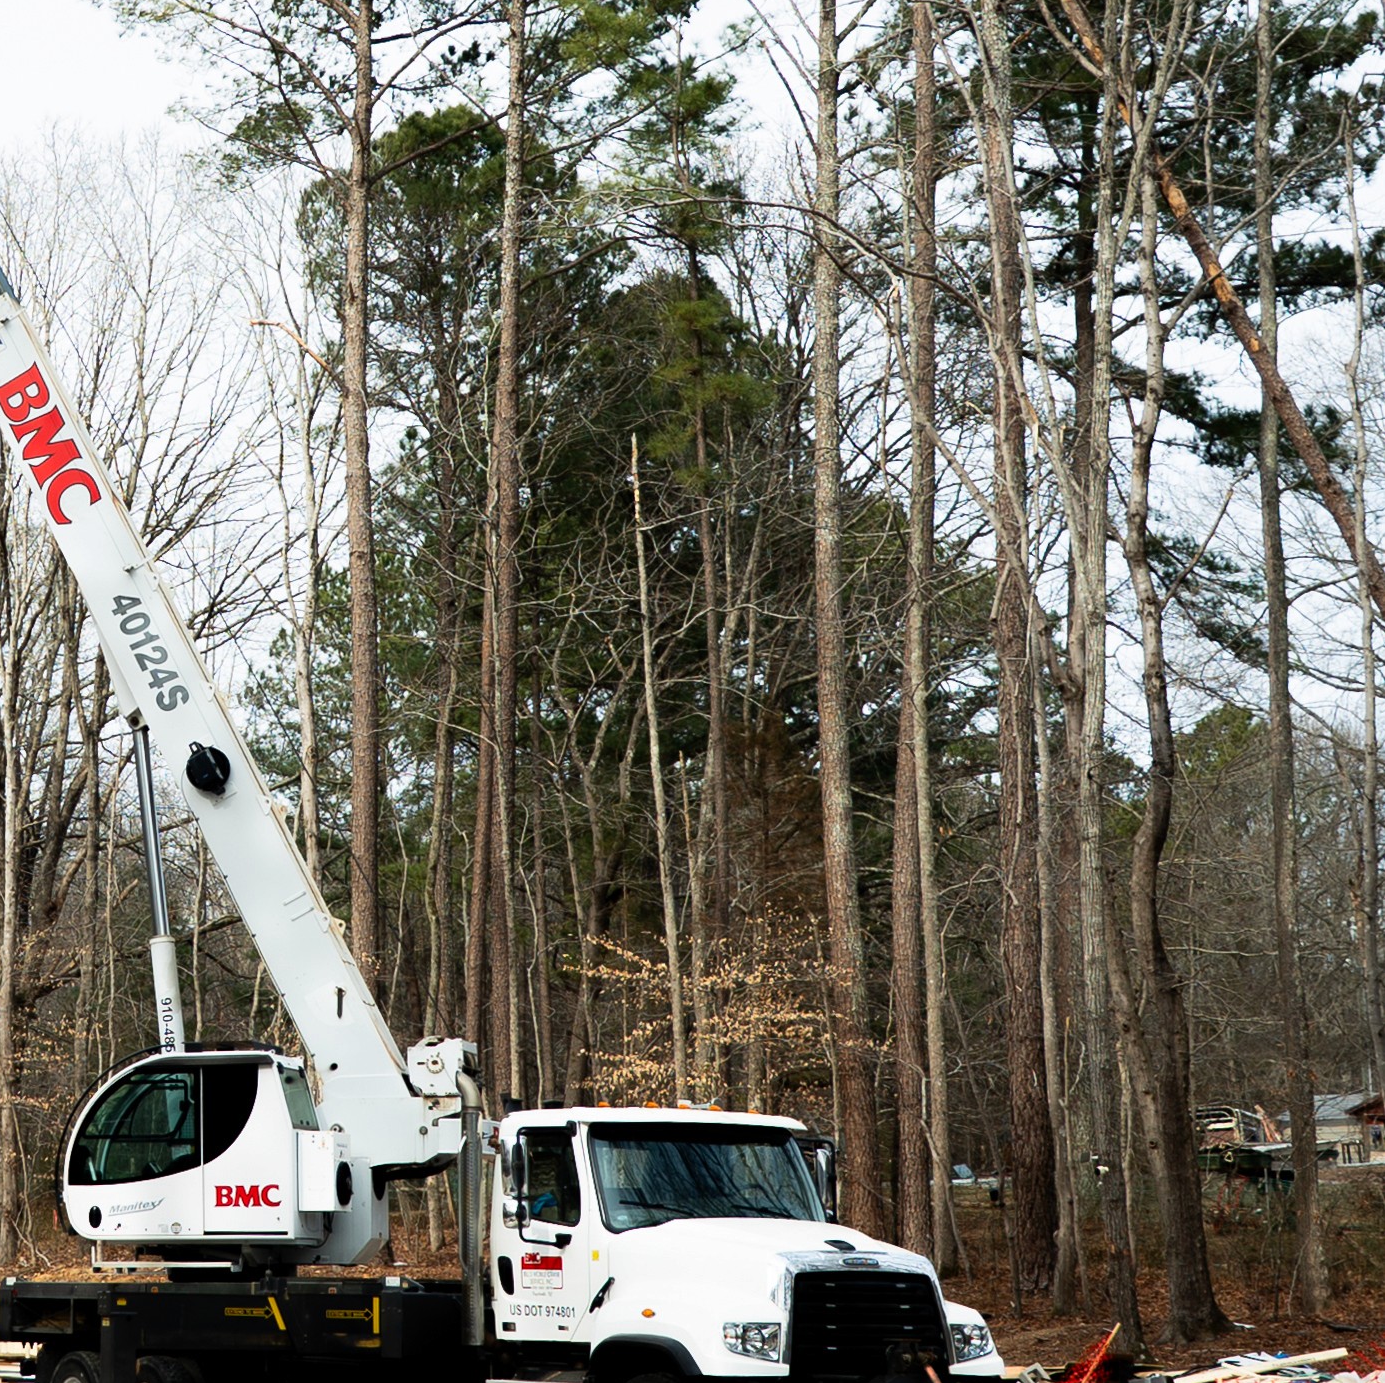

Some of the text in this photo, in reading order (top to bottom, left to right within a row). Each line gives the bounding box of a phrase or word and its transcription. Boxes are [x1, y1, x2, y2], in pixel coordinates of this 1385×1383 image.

[111, 594, 191, 713] 40124S
[214, 1184, 282, 1208] BMC
[109, 1198, 164, 1215] Manitex
[510, 1304, 522, 1316] US
[524, 1305, 543, 1316] DOT
